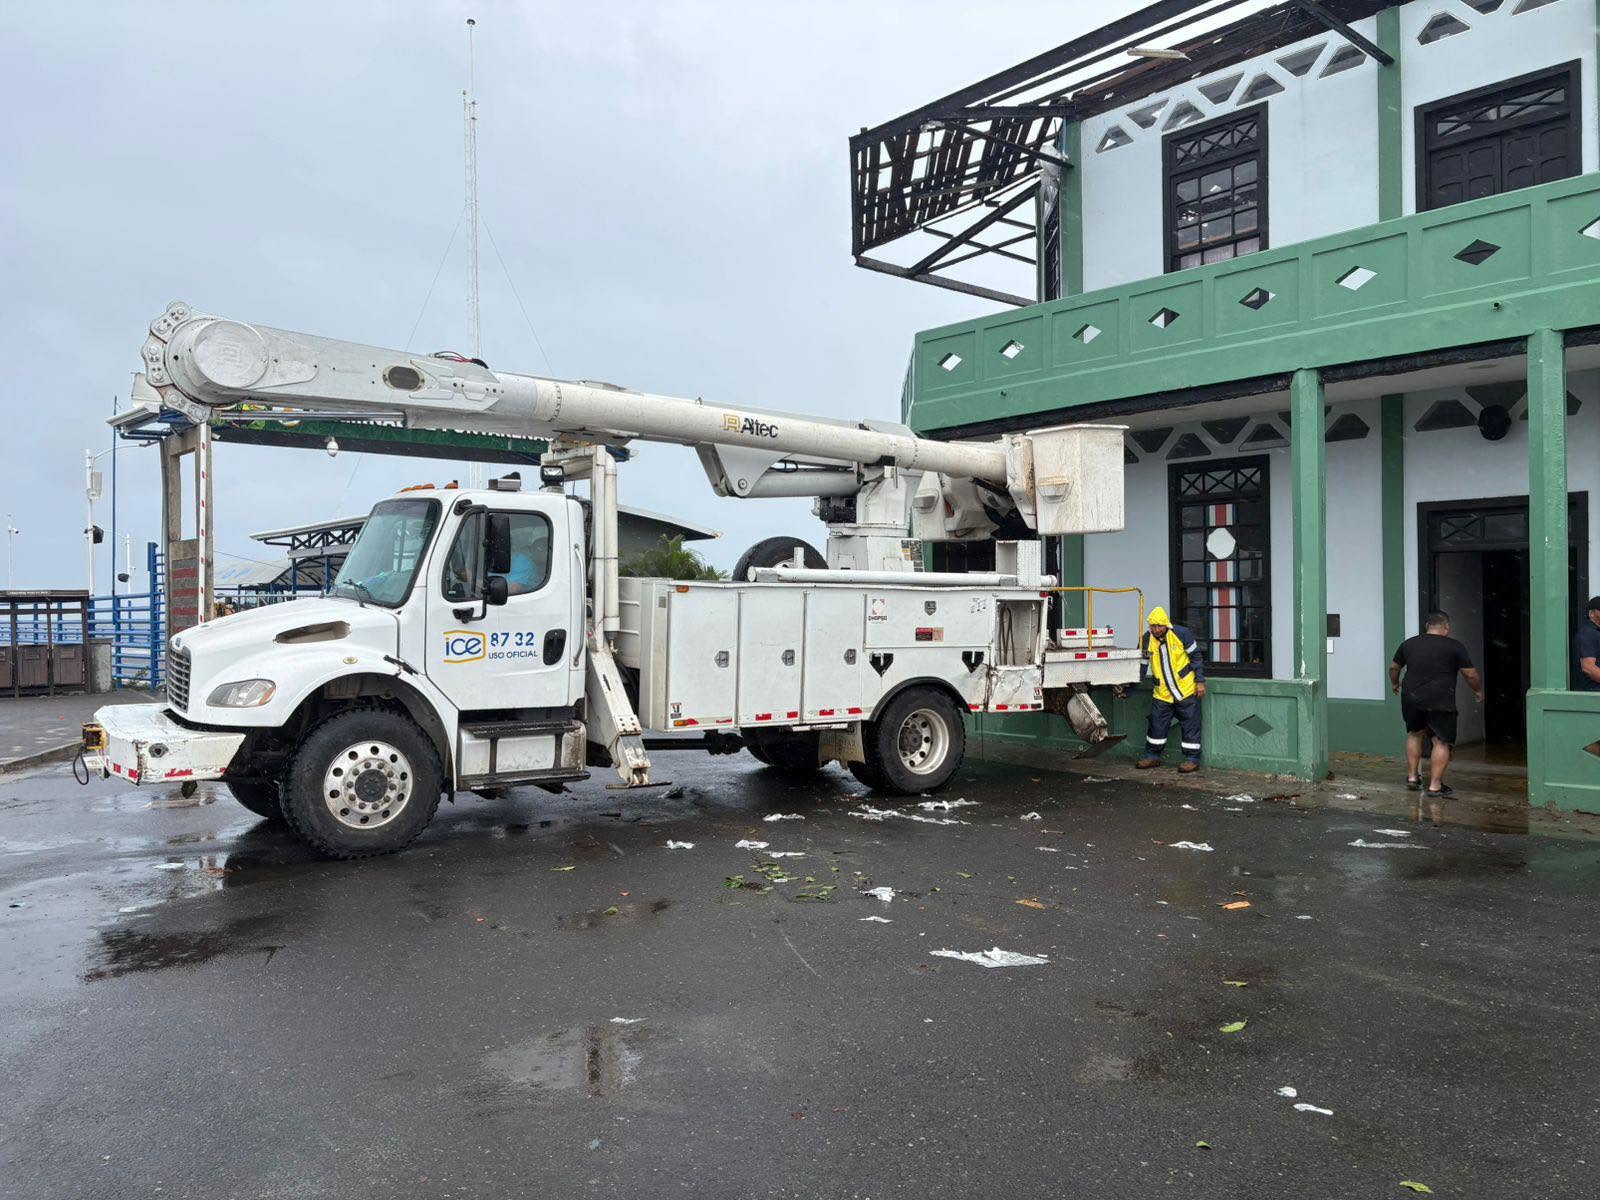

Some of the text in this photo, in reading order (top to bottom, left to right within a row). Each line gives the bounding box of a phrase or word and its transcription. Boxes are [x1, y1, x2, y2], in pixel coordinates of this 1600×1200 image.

[741, 417, 779, 438] Altec
[445, 637, 482, 656] ice
[506, 651, 538, 659] OFICIAL
